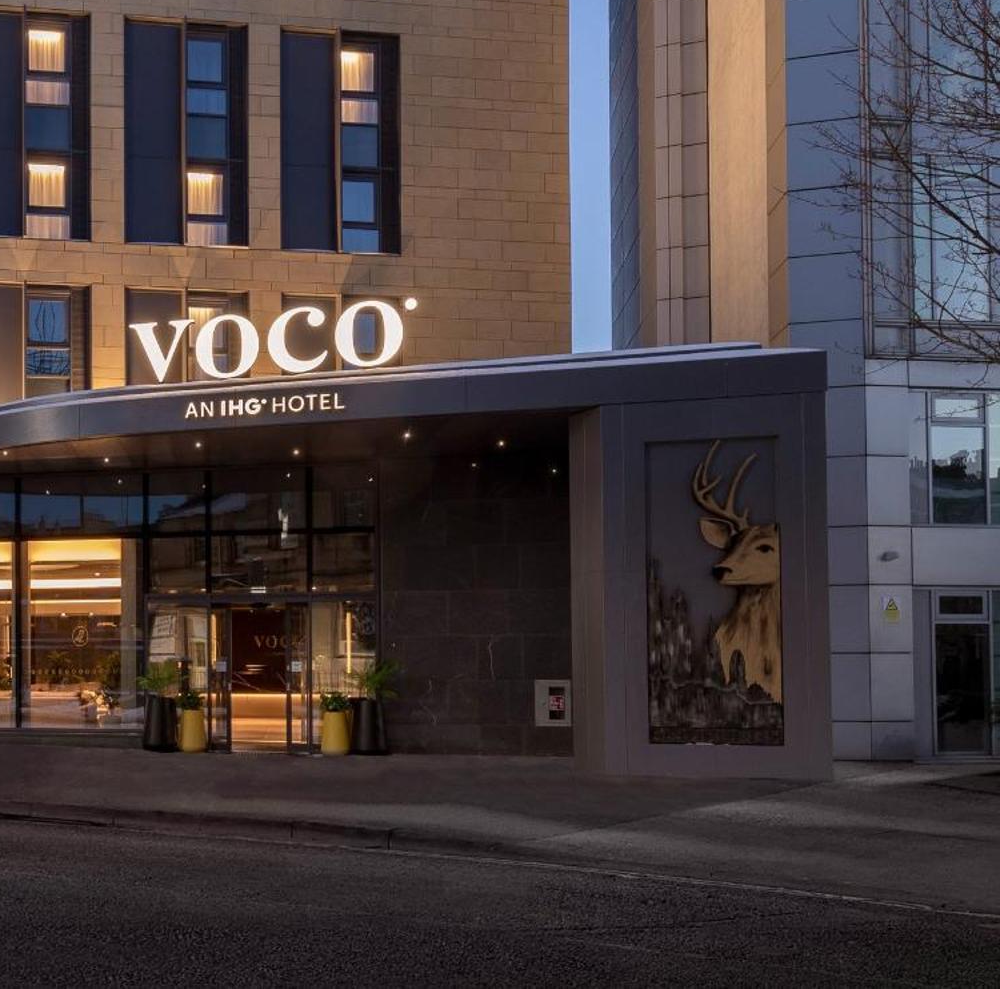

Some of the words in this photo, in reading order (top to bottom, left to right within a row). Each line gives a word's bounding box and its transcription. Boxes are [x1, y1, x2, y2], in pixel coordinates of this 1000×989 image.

[184, 401, 215, 419] AN
[220, 398, 267, 416] IHG
[272, 392, 345, 413] HOTEL
